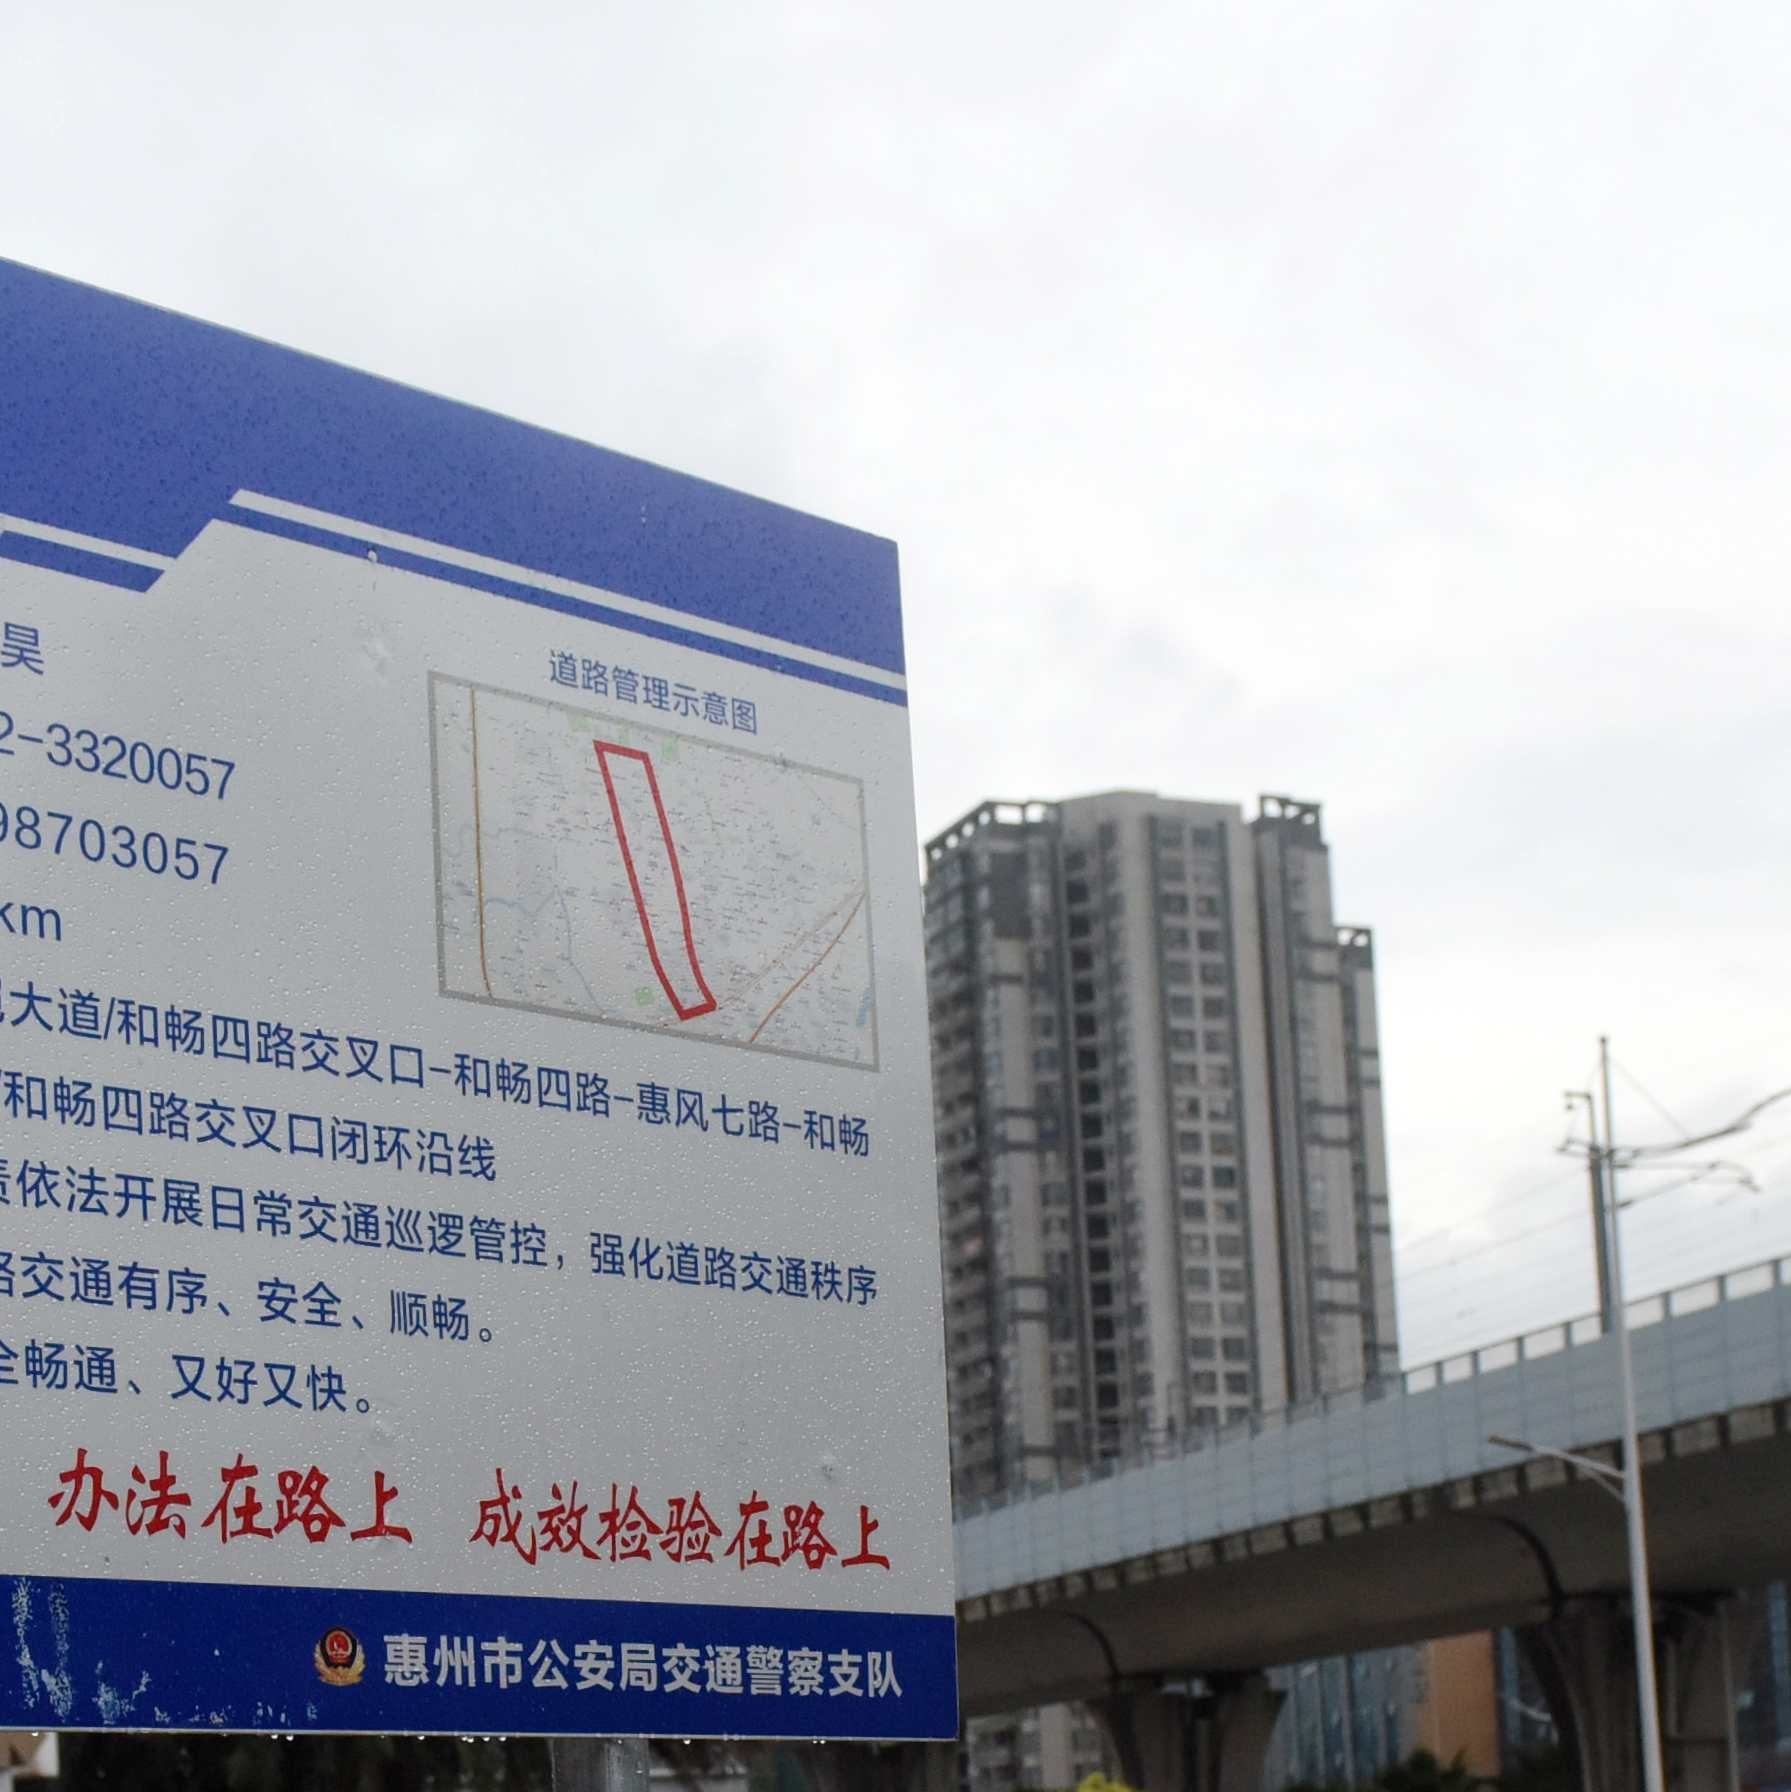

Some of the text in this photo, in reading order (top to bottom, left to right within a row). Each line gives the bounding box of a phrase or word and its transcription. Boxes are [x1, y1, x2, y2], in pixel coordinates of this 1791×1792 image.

[548, 650, 757, 735] 道路管理示意图
[48, 1449, 413, 1543] 办法在路上
[470, 1468, 890, 1571] 成效检验在路上
[382, 1633, 903, 1698] 惠州市公安局交通警察支队
